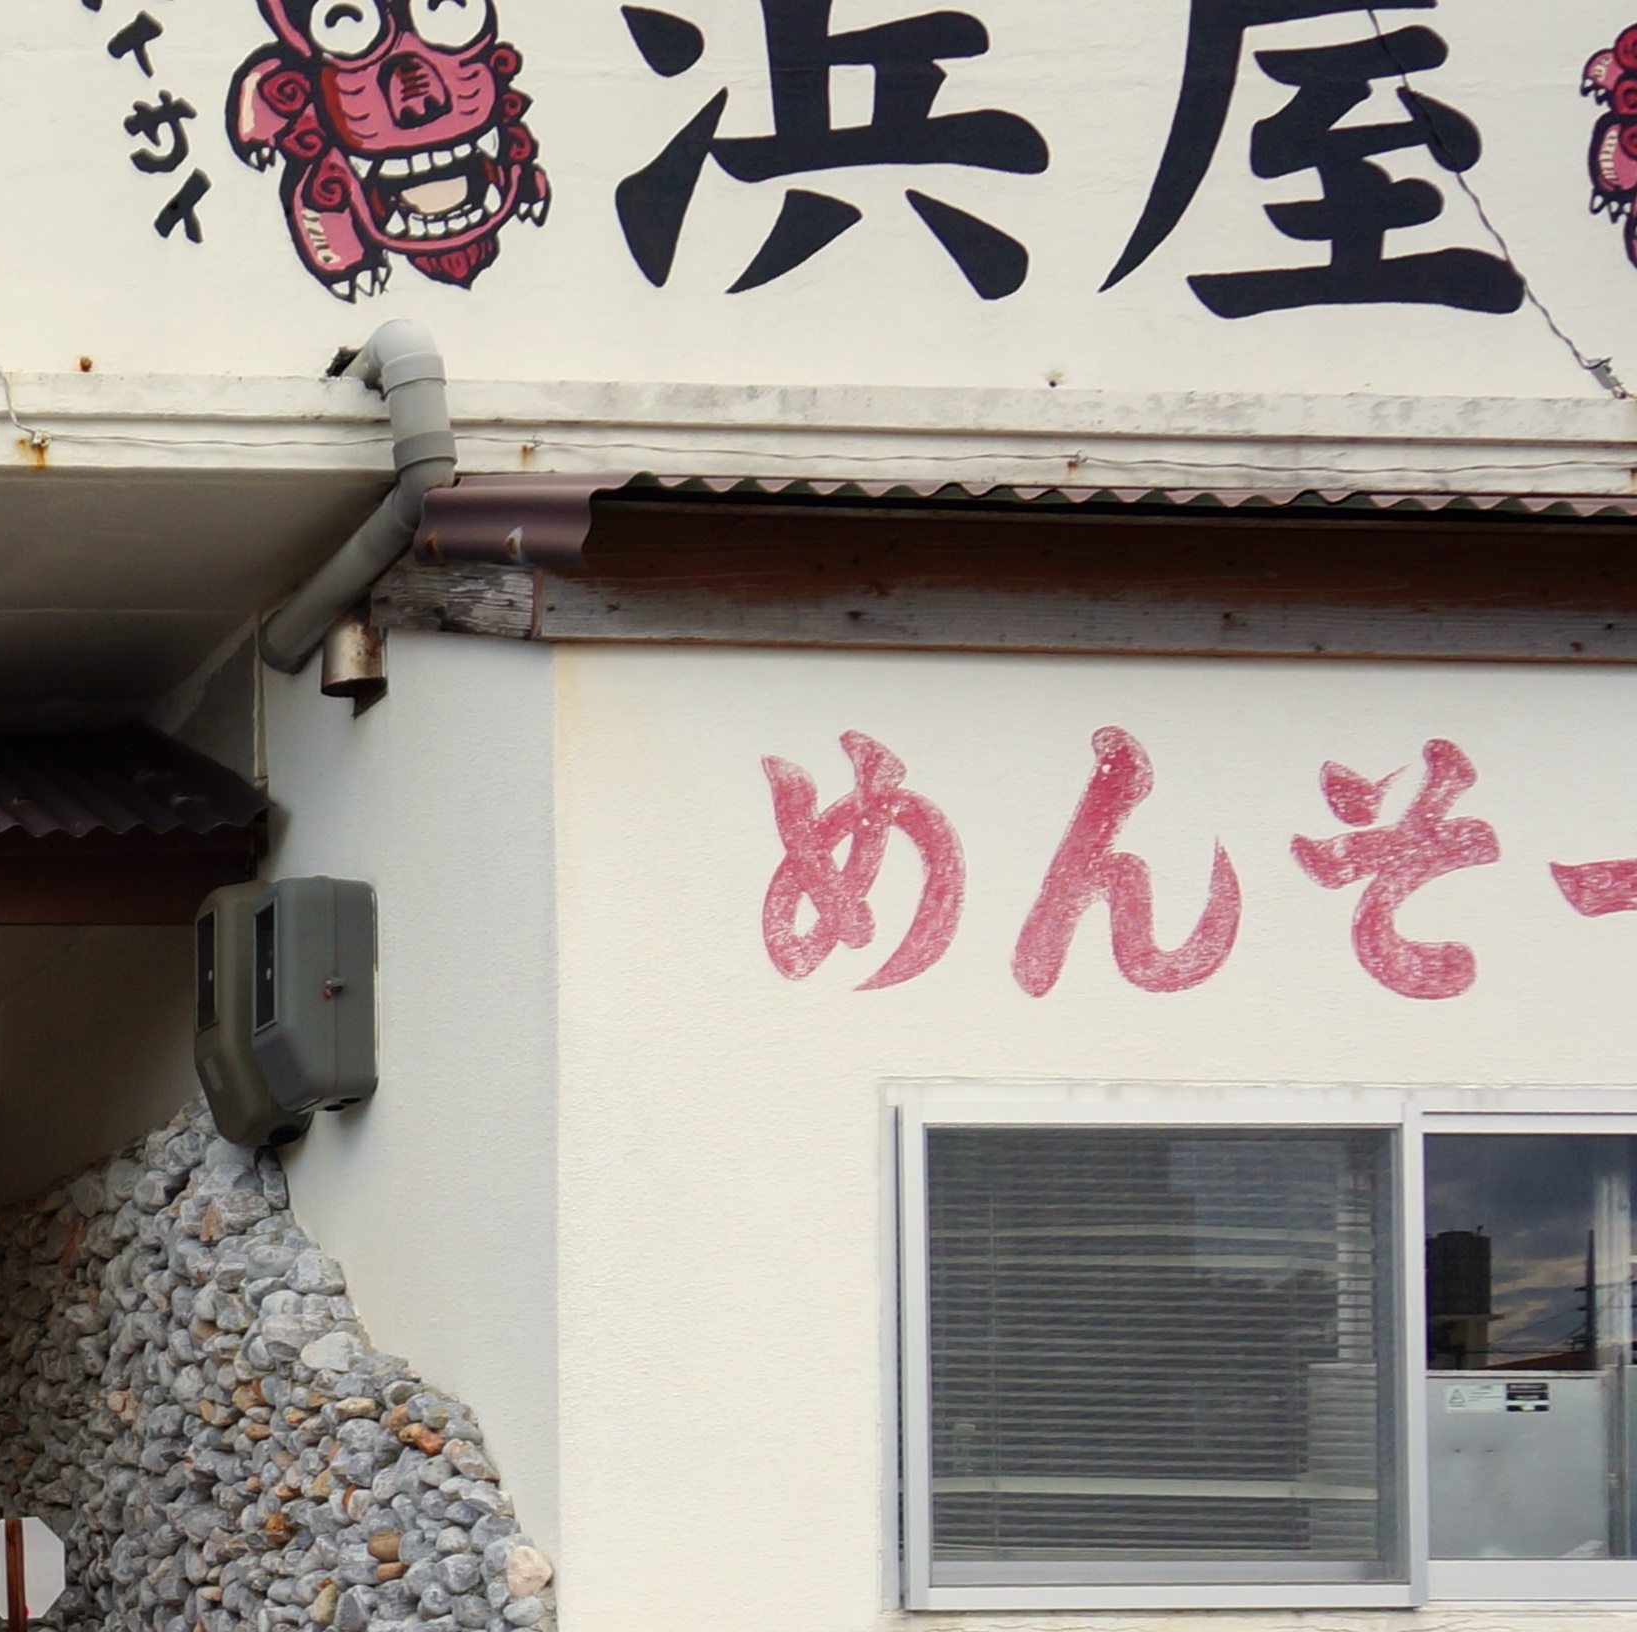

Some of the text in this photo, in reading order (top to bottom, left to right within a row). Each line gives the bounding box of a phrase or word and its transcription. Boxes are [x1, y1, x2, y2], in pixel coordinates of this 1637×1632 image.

[80, 0, 210, 243] イサイ
[616, 0, 1525, 318] 浜屋
